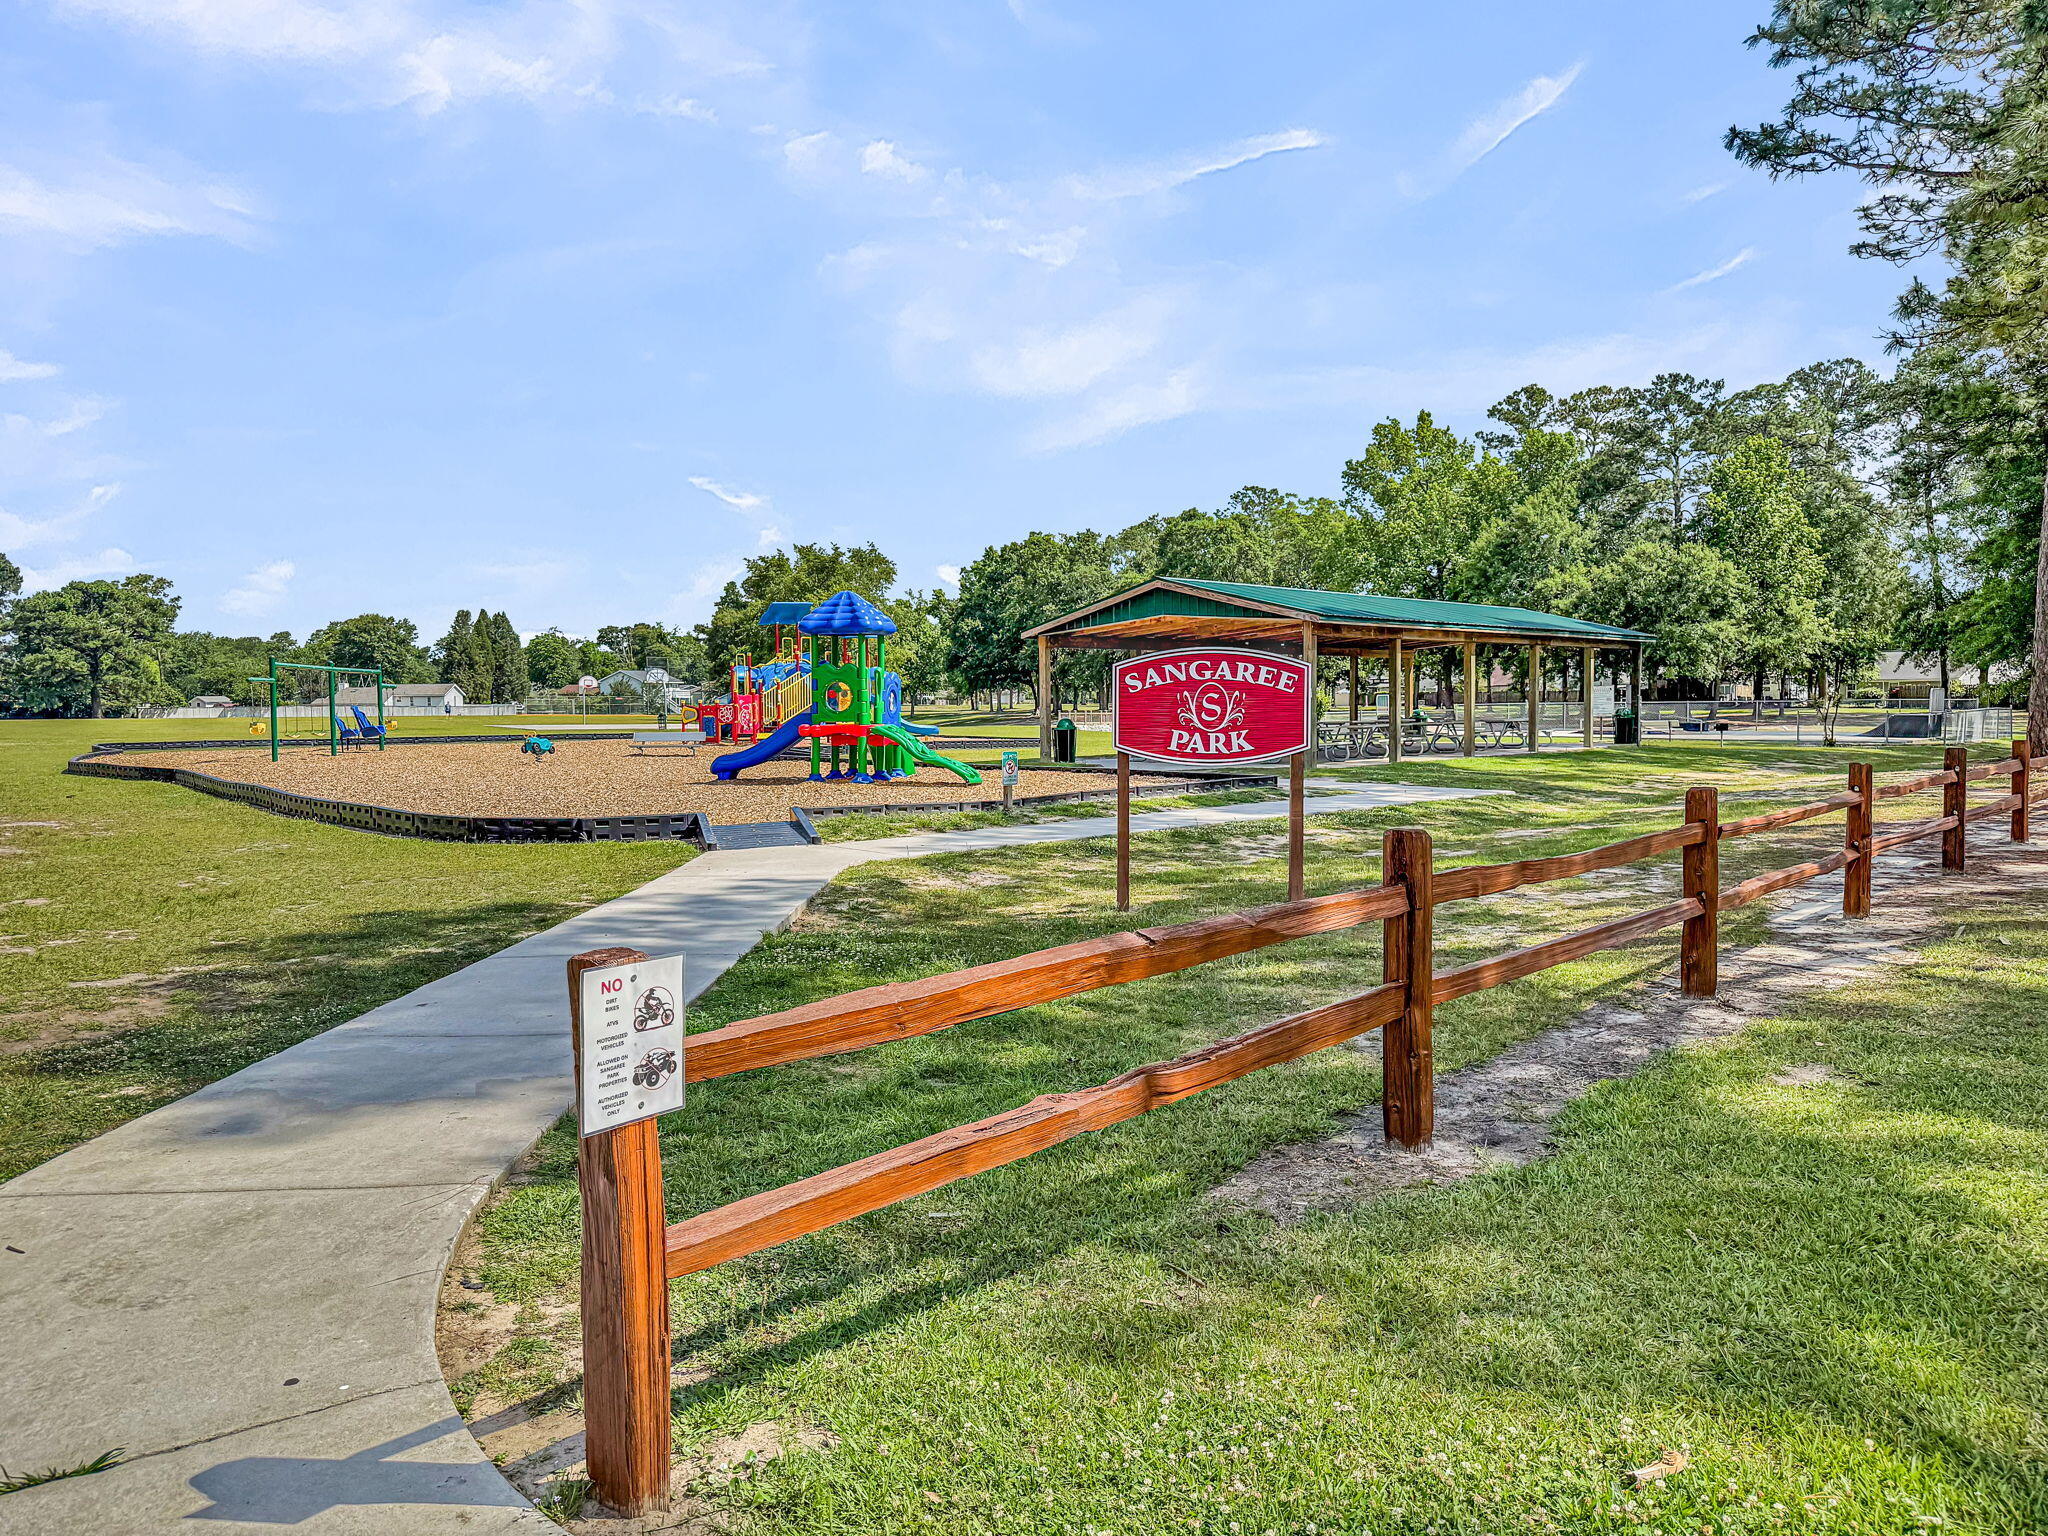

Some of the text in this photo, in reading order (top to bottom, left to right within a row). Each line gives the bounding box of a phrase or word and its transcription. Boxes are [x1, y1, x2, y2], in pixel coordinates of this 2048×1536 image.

[1124, 660, 1298, 693] SANGAREE
[1201, 693, 1222, 721] S
[1167, 729, 1255, 754] PARK
[601, 978, 623, 995] NO
[605, 997, 618, 1005] DIRT
[605, 1004, 620, 1012] BIKES
[596, 1032, 628, 1045] MOTORIZED
[600, 1040, 625, 1051] VEHICLES
[596, 1056, 620, 1067] ALLOWED
[600, 1062, 625, 1073] SANGAREE
[598, 1076, 628, 1089] PROPERTIES
[597, 1091, 629, 1104] AUTHORIZED
[601, 1100, 625, 1111] VEHICLES
[606, 1108, 620, 1117] ONLY
